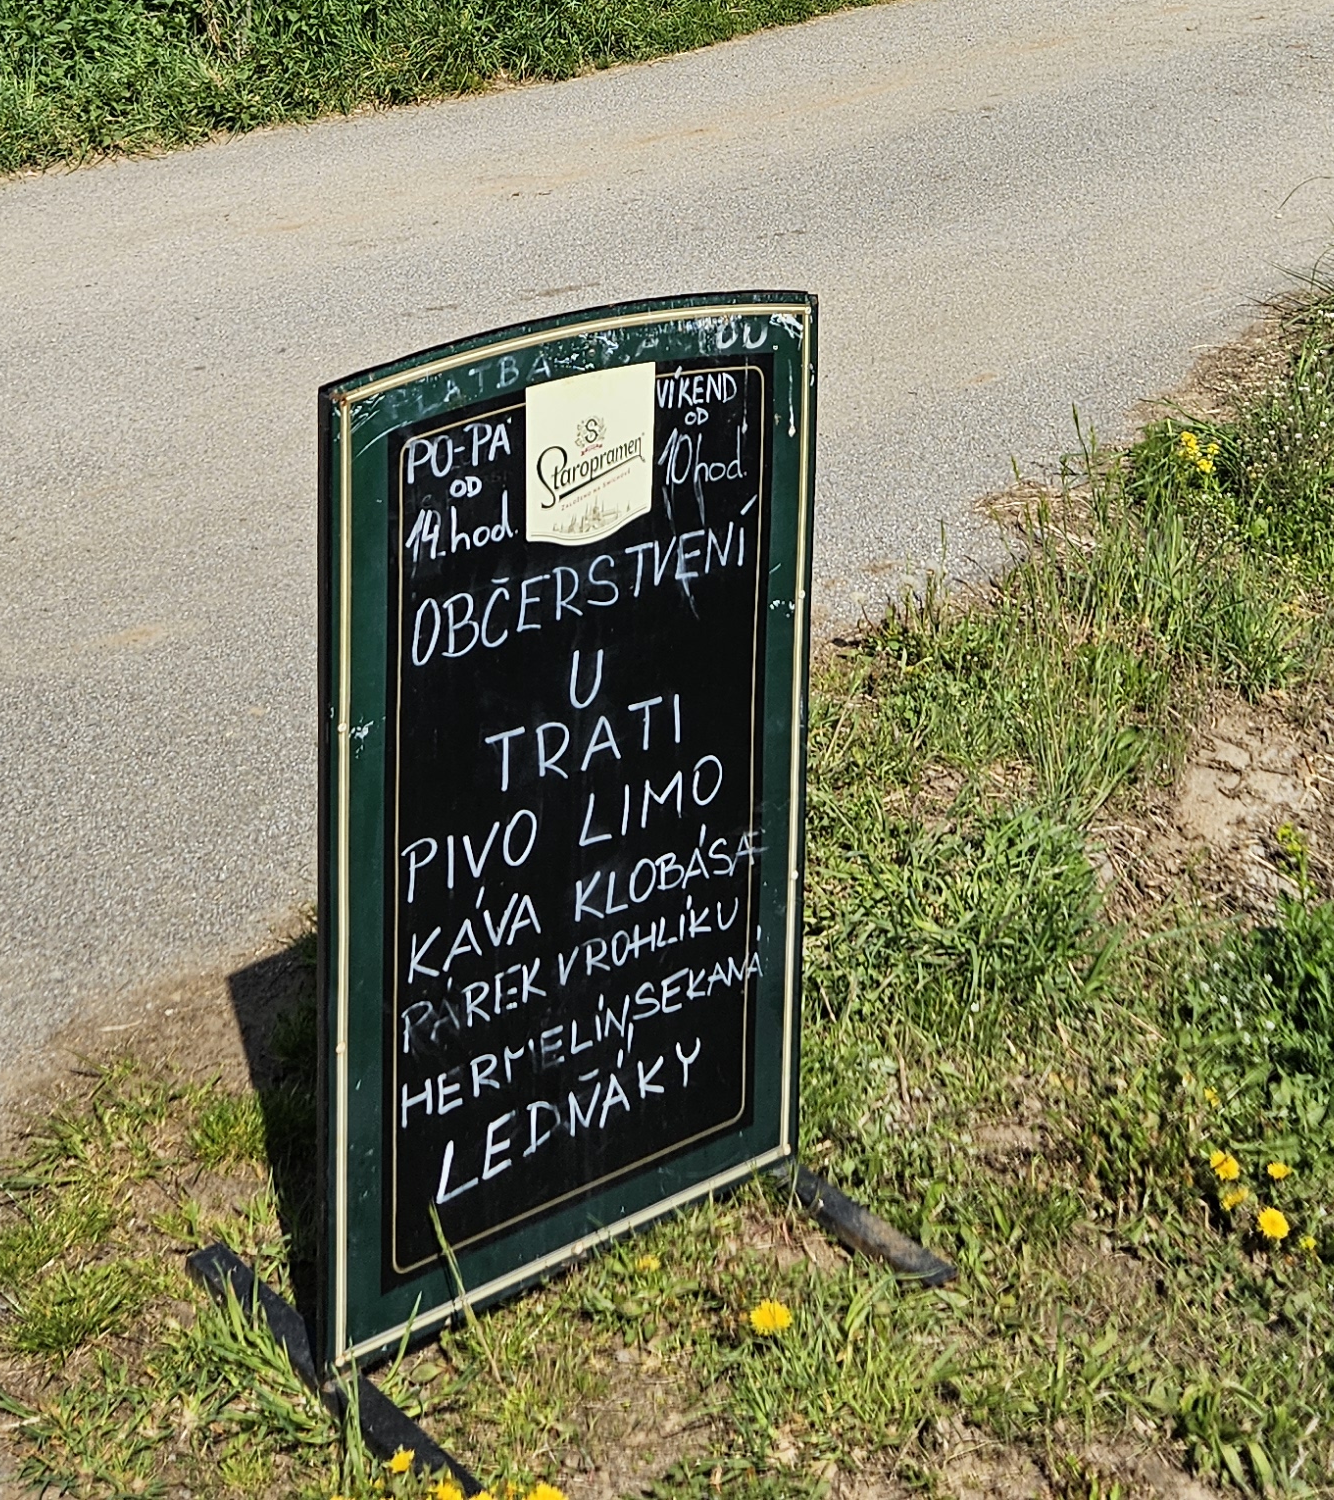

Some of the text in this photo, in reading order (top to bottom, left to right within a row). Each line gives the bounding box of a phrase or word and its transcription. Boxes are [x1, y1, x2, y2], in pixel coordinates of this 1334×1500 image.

[657, 366, 738, 409] VÍKEND
[685, 407, 709, 425] OD
[450, 476, 482, 498] OD
[536, 435, 645, 510] Staropramen
[411, 494, 759, 667] OBČERSTVENÍ
[569, 649, 605, 709] U
[484, 693, 683, 793] TRATI
[401, 754, 722, 903] PIVO LIMO
[407, 824, 763, 984] KÁVA KLOBÁSA
[401, 957, 547, 1053] PÁREK
[434, 1036, 702, 1205] LEDŇÁKY
